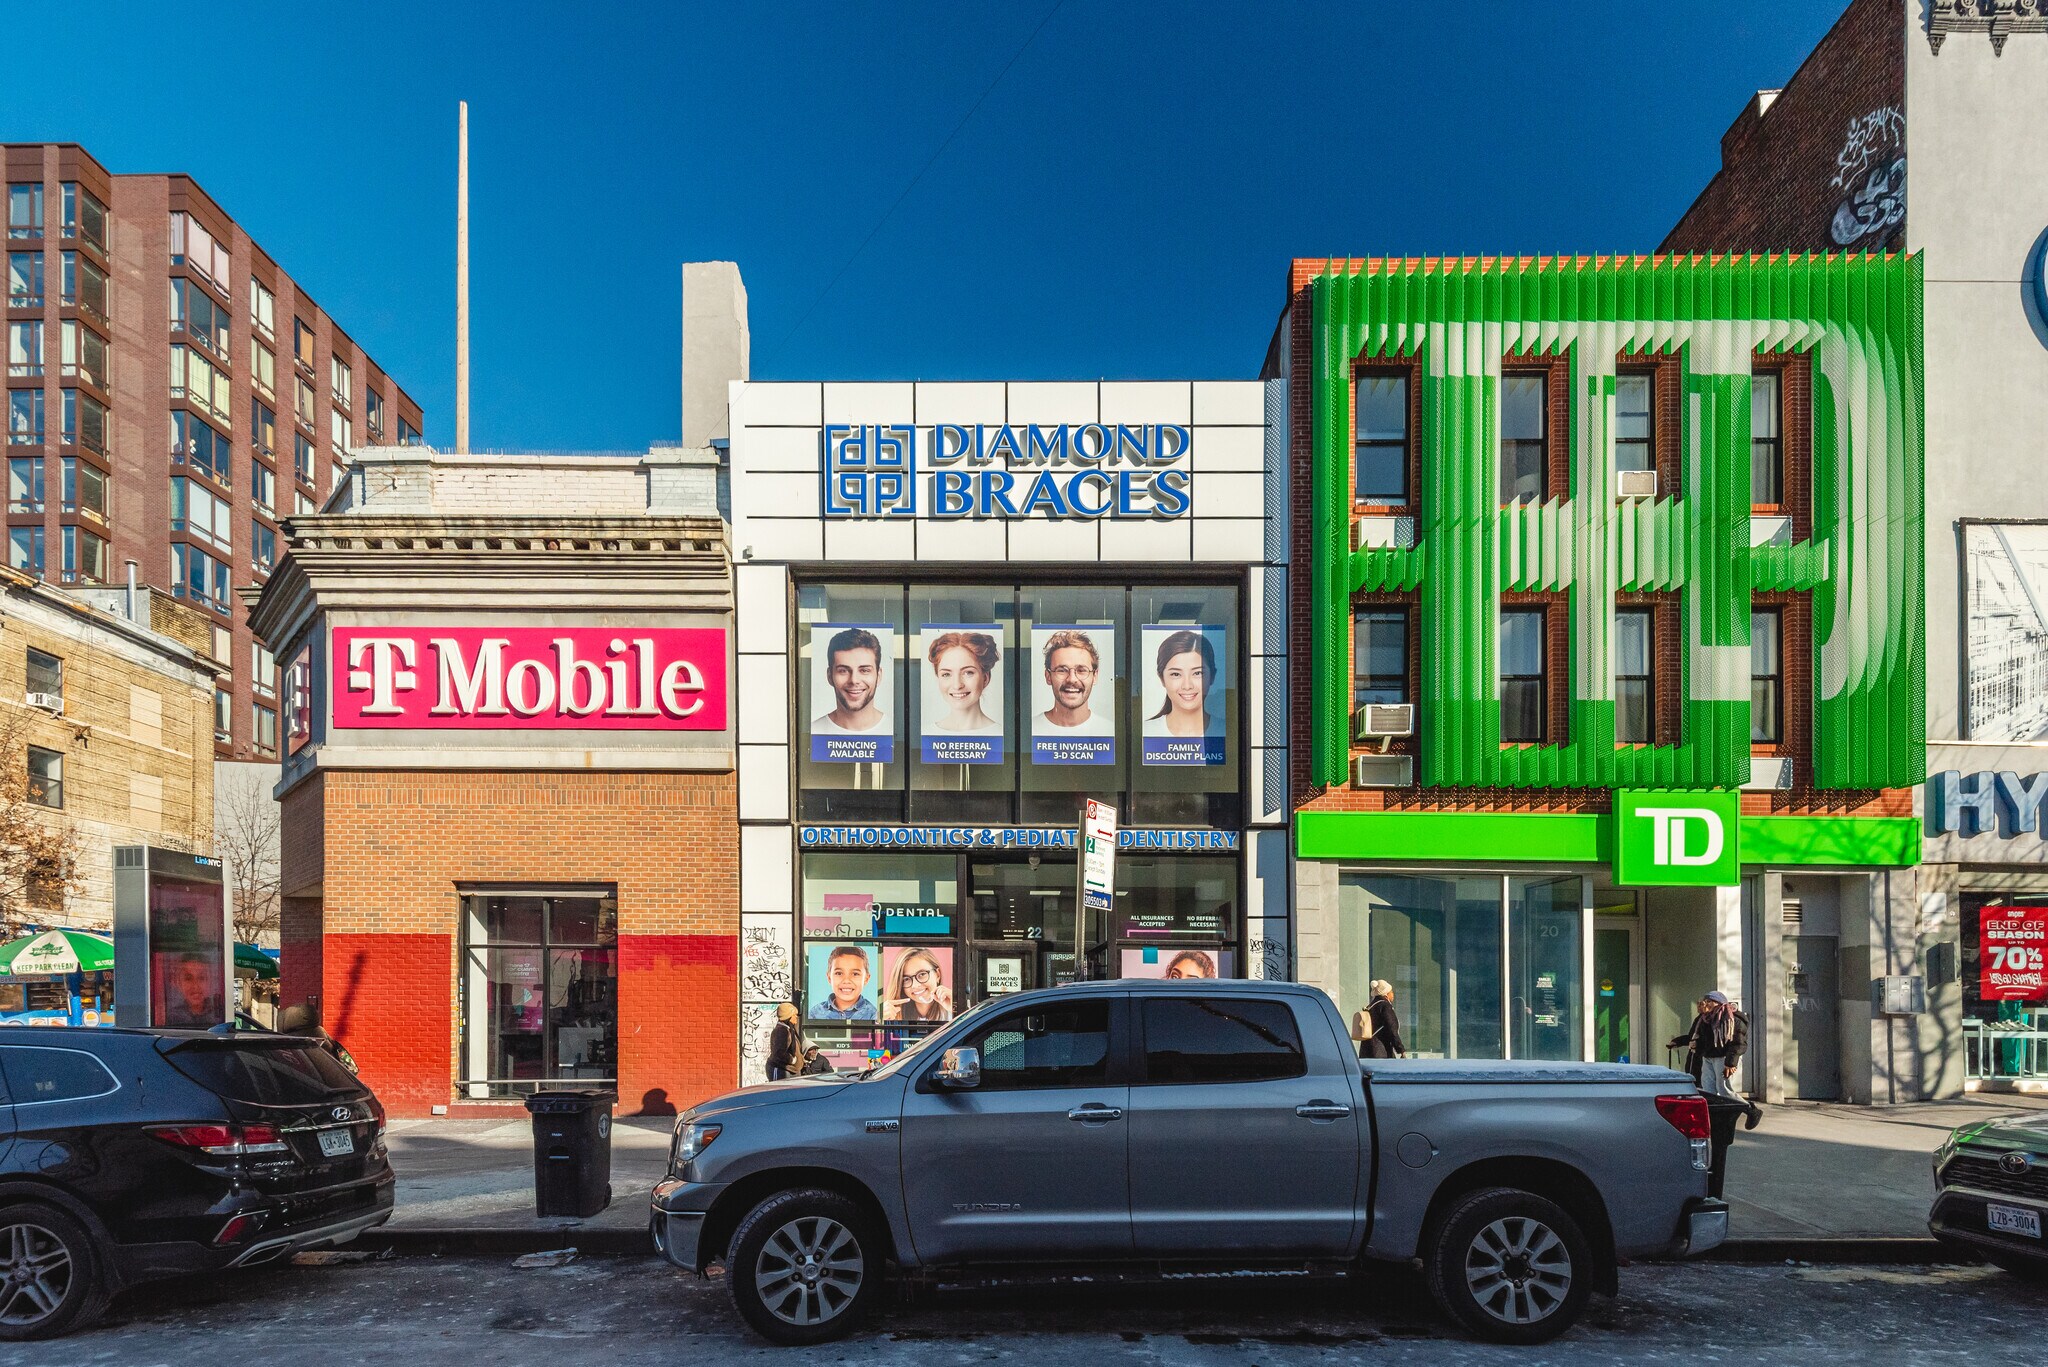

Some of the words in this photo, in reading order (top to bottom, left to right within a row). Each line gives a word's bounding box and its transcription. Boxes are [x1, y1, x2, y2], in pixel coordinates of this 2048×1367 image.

[935, 423, 1190, 462] DIAMOND
[935, 469, 1190, 517] BRACES
[827, 741, 877, 750] FINANCING
[932, 742, 947, 750] NO
[949, 742, 992, 750] REFERRAL
[1037, 742, 1058, 751] FREE
[1059, 742, 1110, 751] INVISALIGN
[1168, 743, 1201, 752] FAMILY
[830, 750, 875, 759] AVALABLE
[937, 751, 987, 760] NECESSARY
[1053, 752, 1068, 760] 3-D
[1070, 752, 1094, 760] SCAN
[1146, 752, 1192, 761] DISCOUNT
[1193, 752, 1223, 761] PLANS
[802, 826, 974, 846] ORTHODONTICS
[980, 828, 996, 846] &
[1003, 828, 1078, 848] PEDIAT
[1119, 830, 1237, 848] DENTISTRY
[1634, 807, 1724, 866] TD
[886, 908, 944, 917] DENTAL
[1986, 920, 2020, 930] END
[2022, 920, 2045, 930] OF
[1027, 926, 1042, 939] 22
[1540, 925, 1559, 938] 20
[1988, 931, 2045, 939] SEASON
[16, 963, 33, 973] KEEP
[34, 962, 52, 972] PARK
[53, 961, 74, 971] CLEAN
[953, 1203, 1022, 1211] TUNDRA
